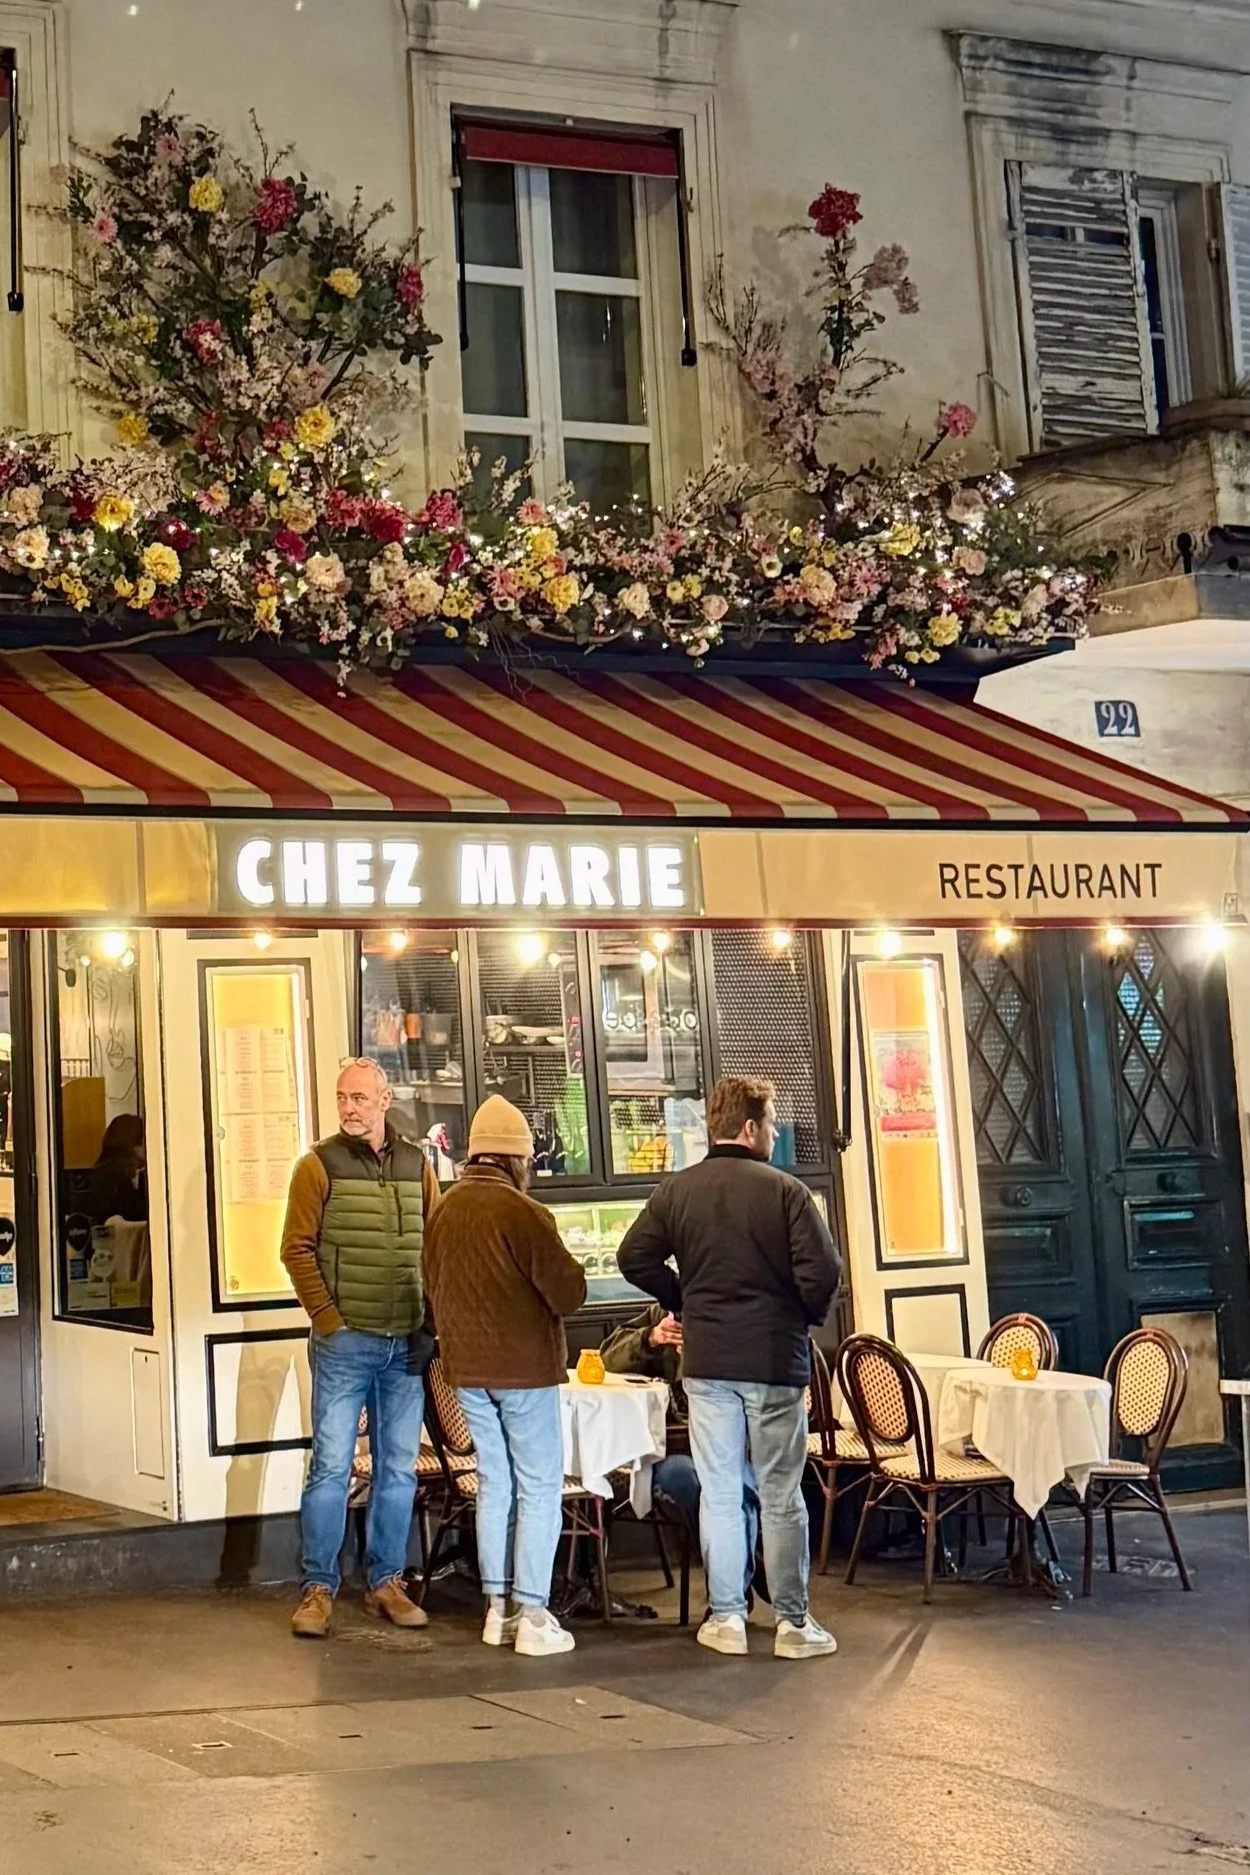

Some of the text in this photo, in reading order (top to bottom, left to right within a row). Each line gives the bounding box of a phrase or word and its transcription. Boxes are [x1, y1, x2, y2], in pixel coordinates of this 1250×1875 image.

[1101, 702, 1136, 735] 22
[236, 838, 686, 908] CHEZ MARIE
[938, 863, 1163, 900] RESTAURANT
